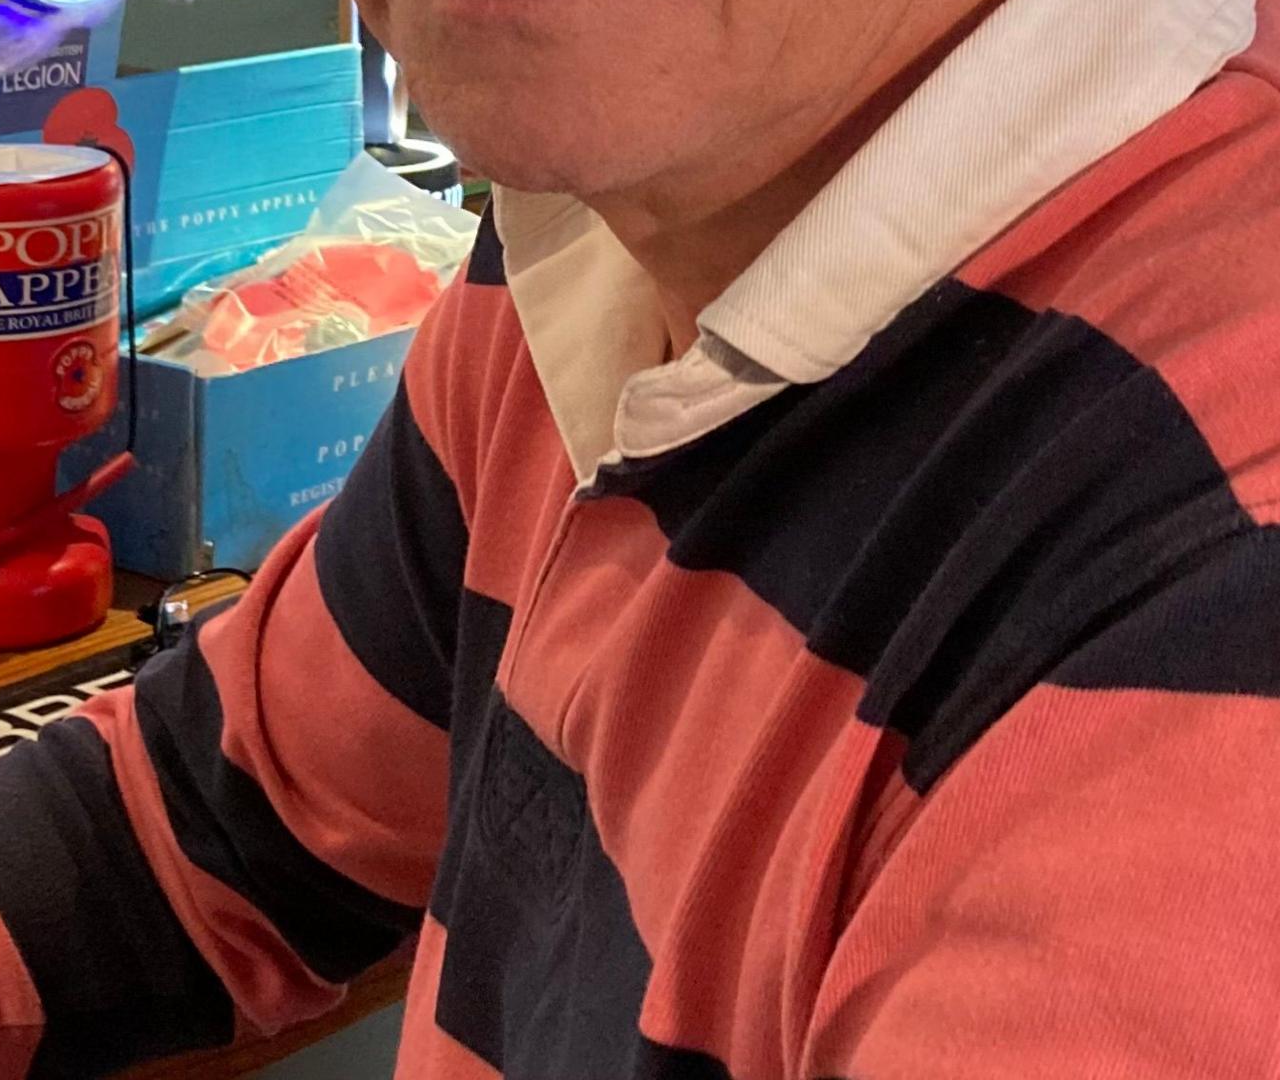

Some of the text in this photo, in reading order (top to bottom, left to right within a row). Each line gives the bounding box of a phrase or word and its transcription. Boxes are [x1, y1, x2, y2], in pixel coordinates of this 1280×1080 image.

[2, 61, 82, 94] LEGION
[180, 204, 241, 230] POPPY
[248, 189, 318, 217] APPEAL
[7, 313, 61, 331] ROYAL
[63, 303, 98, 325] BRIT
[331, 361, 395, 393] PLEA
[316, 434, 366, 464] POP
[289, 476, 347, 508] REGIST
